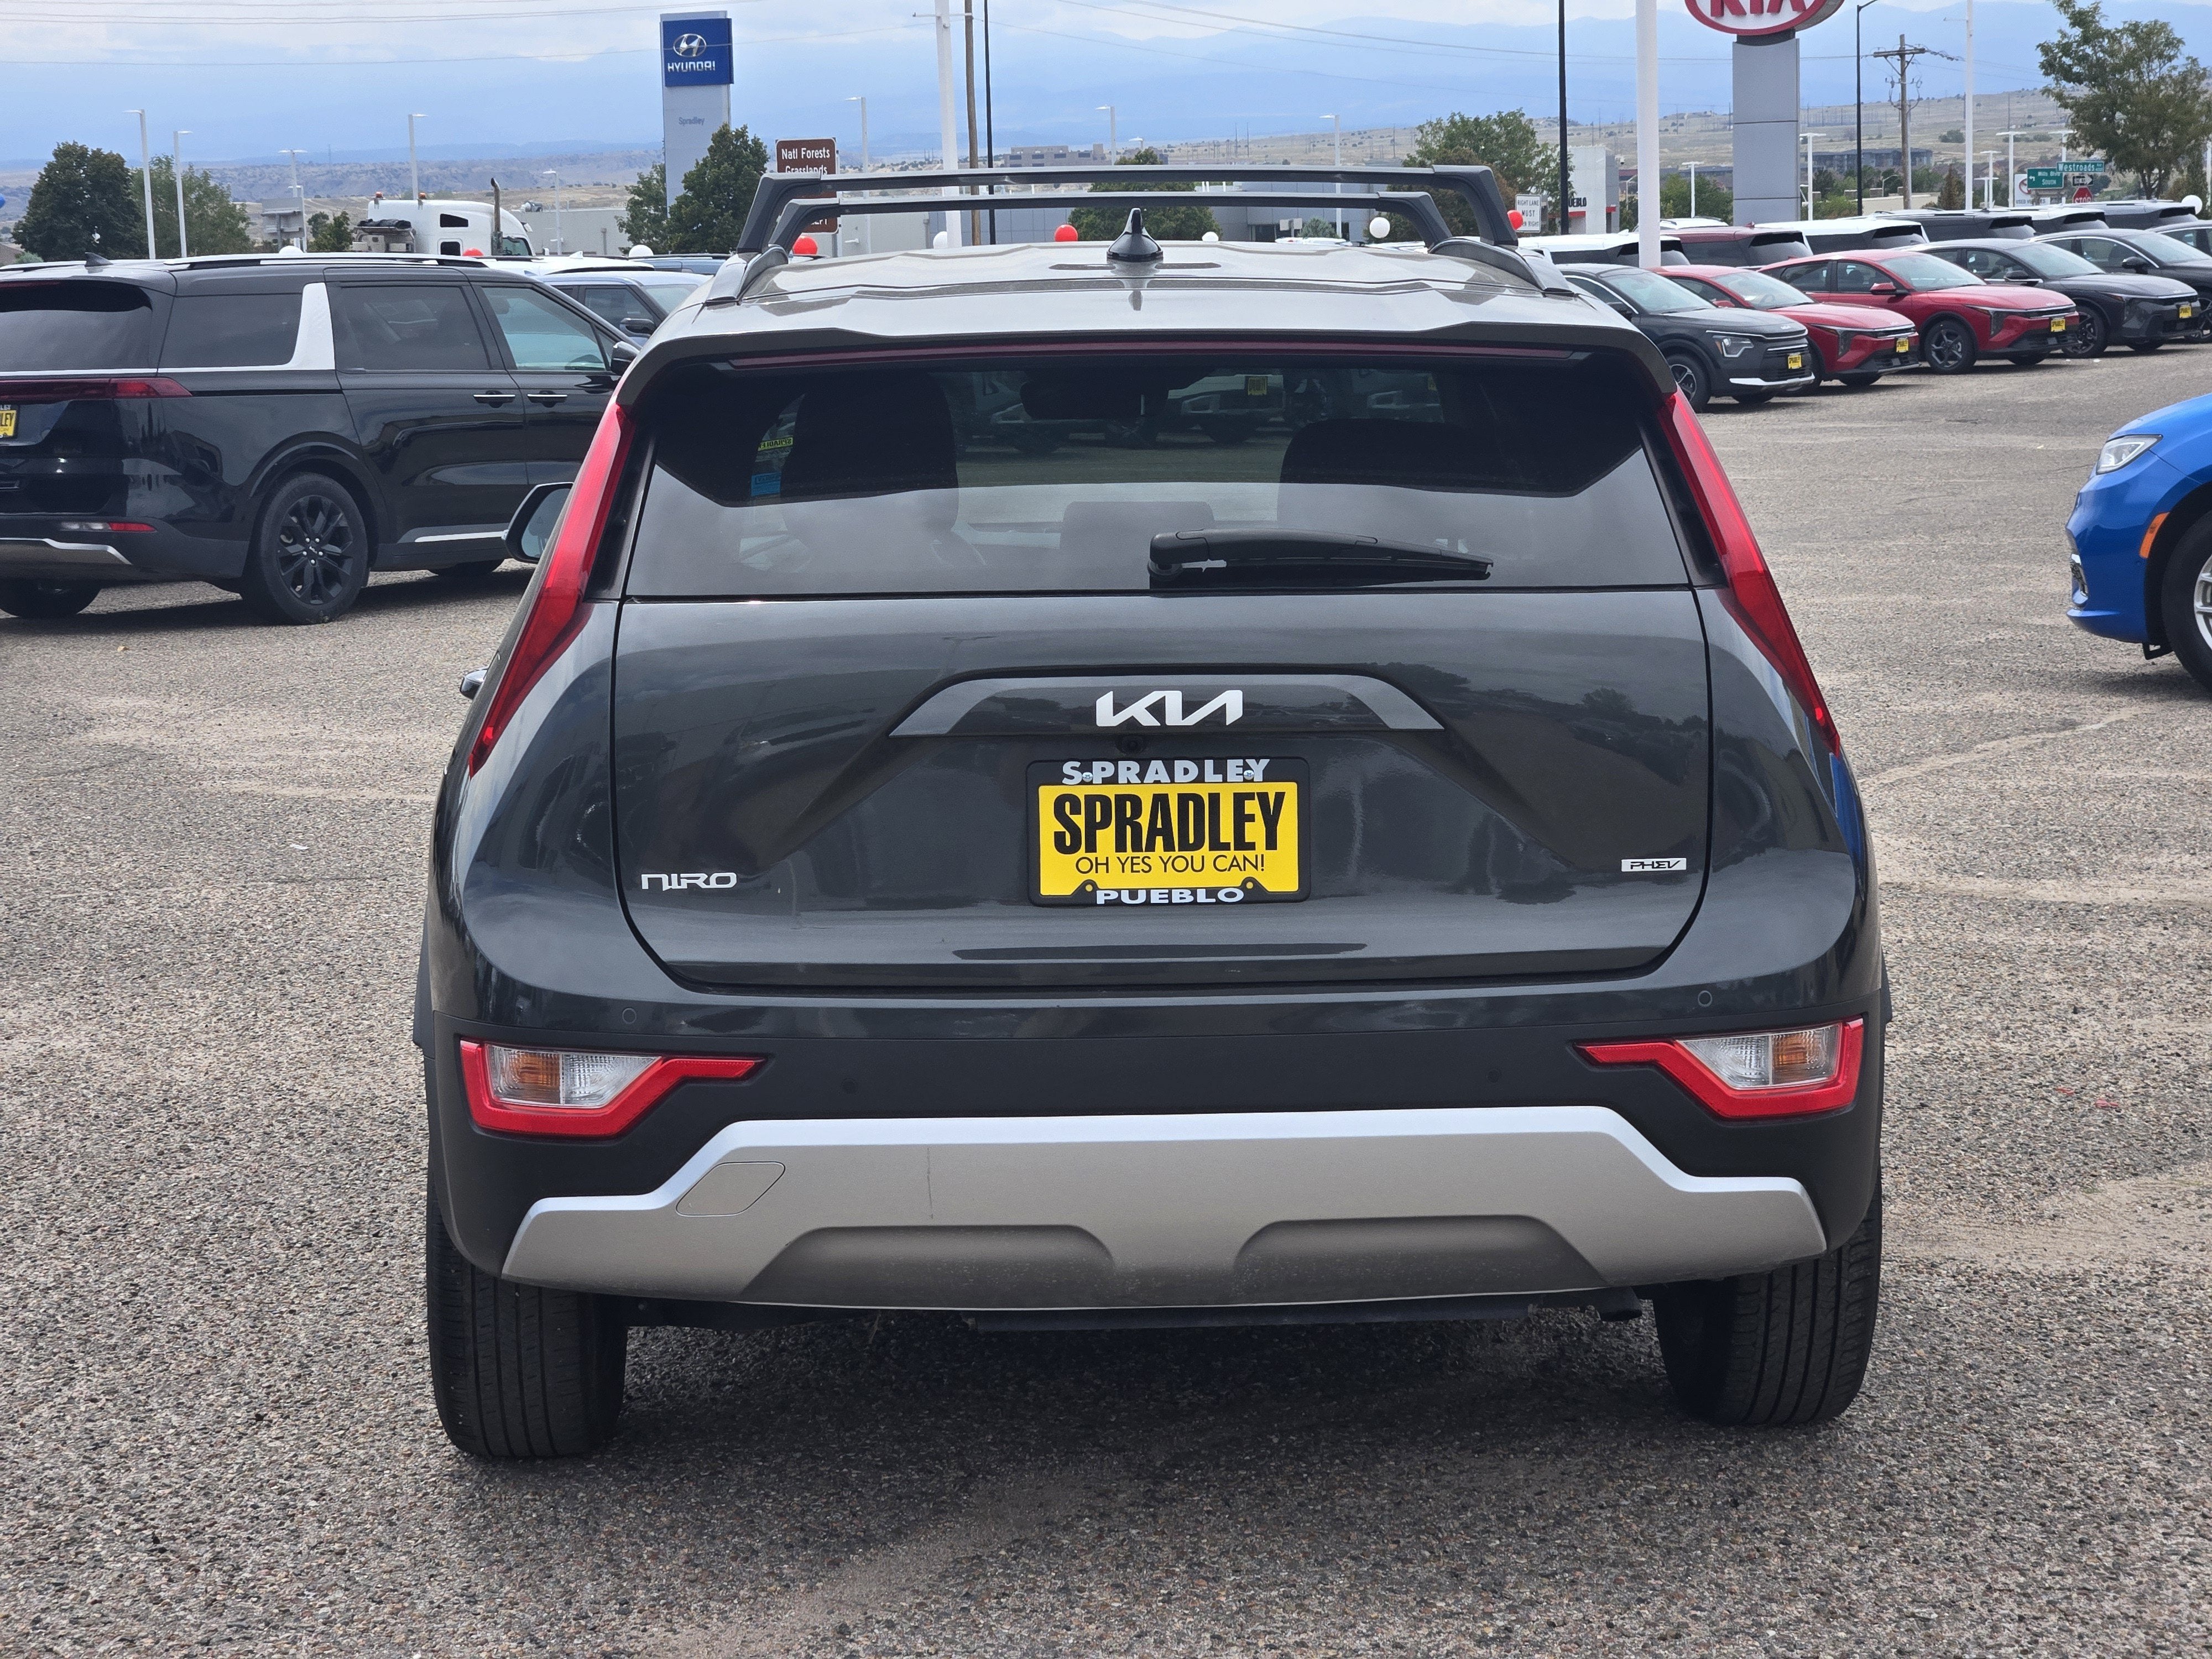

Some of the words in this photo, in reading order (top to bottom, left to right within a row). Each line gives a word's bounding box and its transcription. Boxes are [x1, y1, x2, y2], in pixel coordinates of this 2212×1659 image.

[667, 60, 715, 72] HYUNDAI
[678, 116, 705, 127] Spradley
[781, 148, 798, 159] Natl
[801, 147, 830, 159] Forests
[785, 165, 827, 175] Grasslands
[2058, 163, 2095, 171] Westroads
[1568, 197, 1587, 207] UEBLO
[1096, 690, 1243, 727] KIA
[1062, 759, 1270, 785] SPRADLEY
[1053, 791, 1286, 854] SPRADLEY
[1075, 856, 1109, 874] OH
[1117, 855, 1152, 874] YES
[1159, 855, 1205, 873] YOU
[1213, 854, 1265, 873] CAN!
[1630, 860, 1681, 870] PHEV
[1096, 888, 1244, 905] PUEBLO
